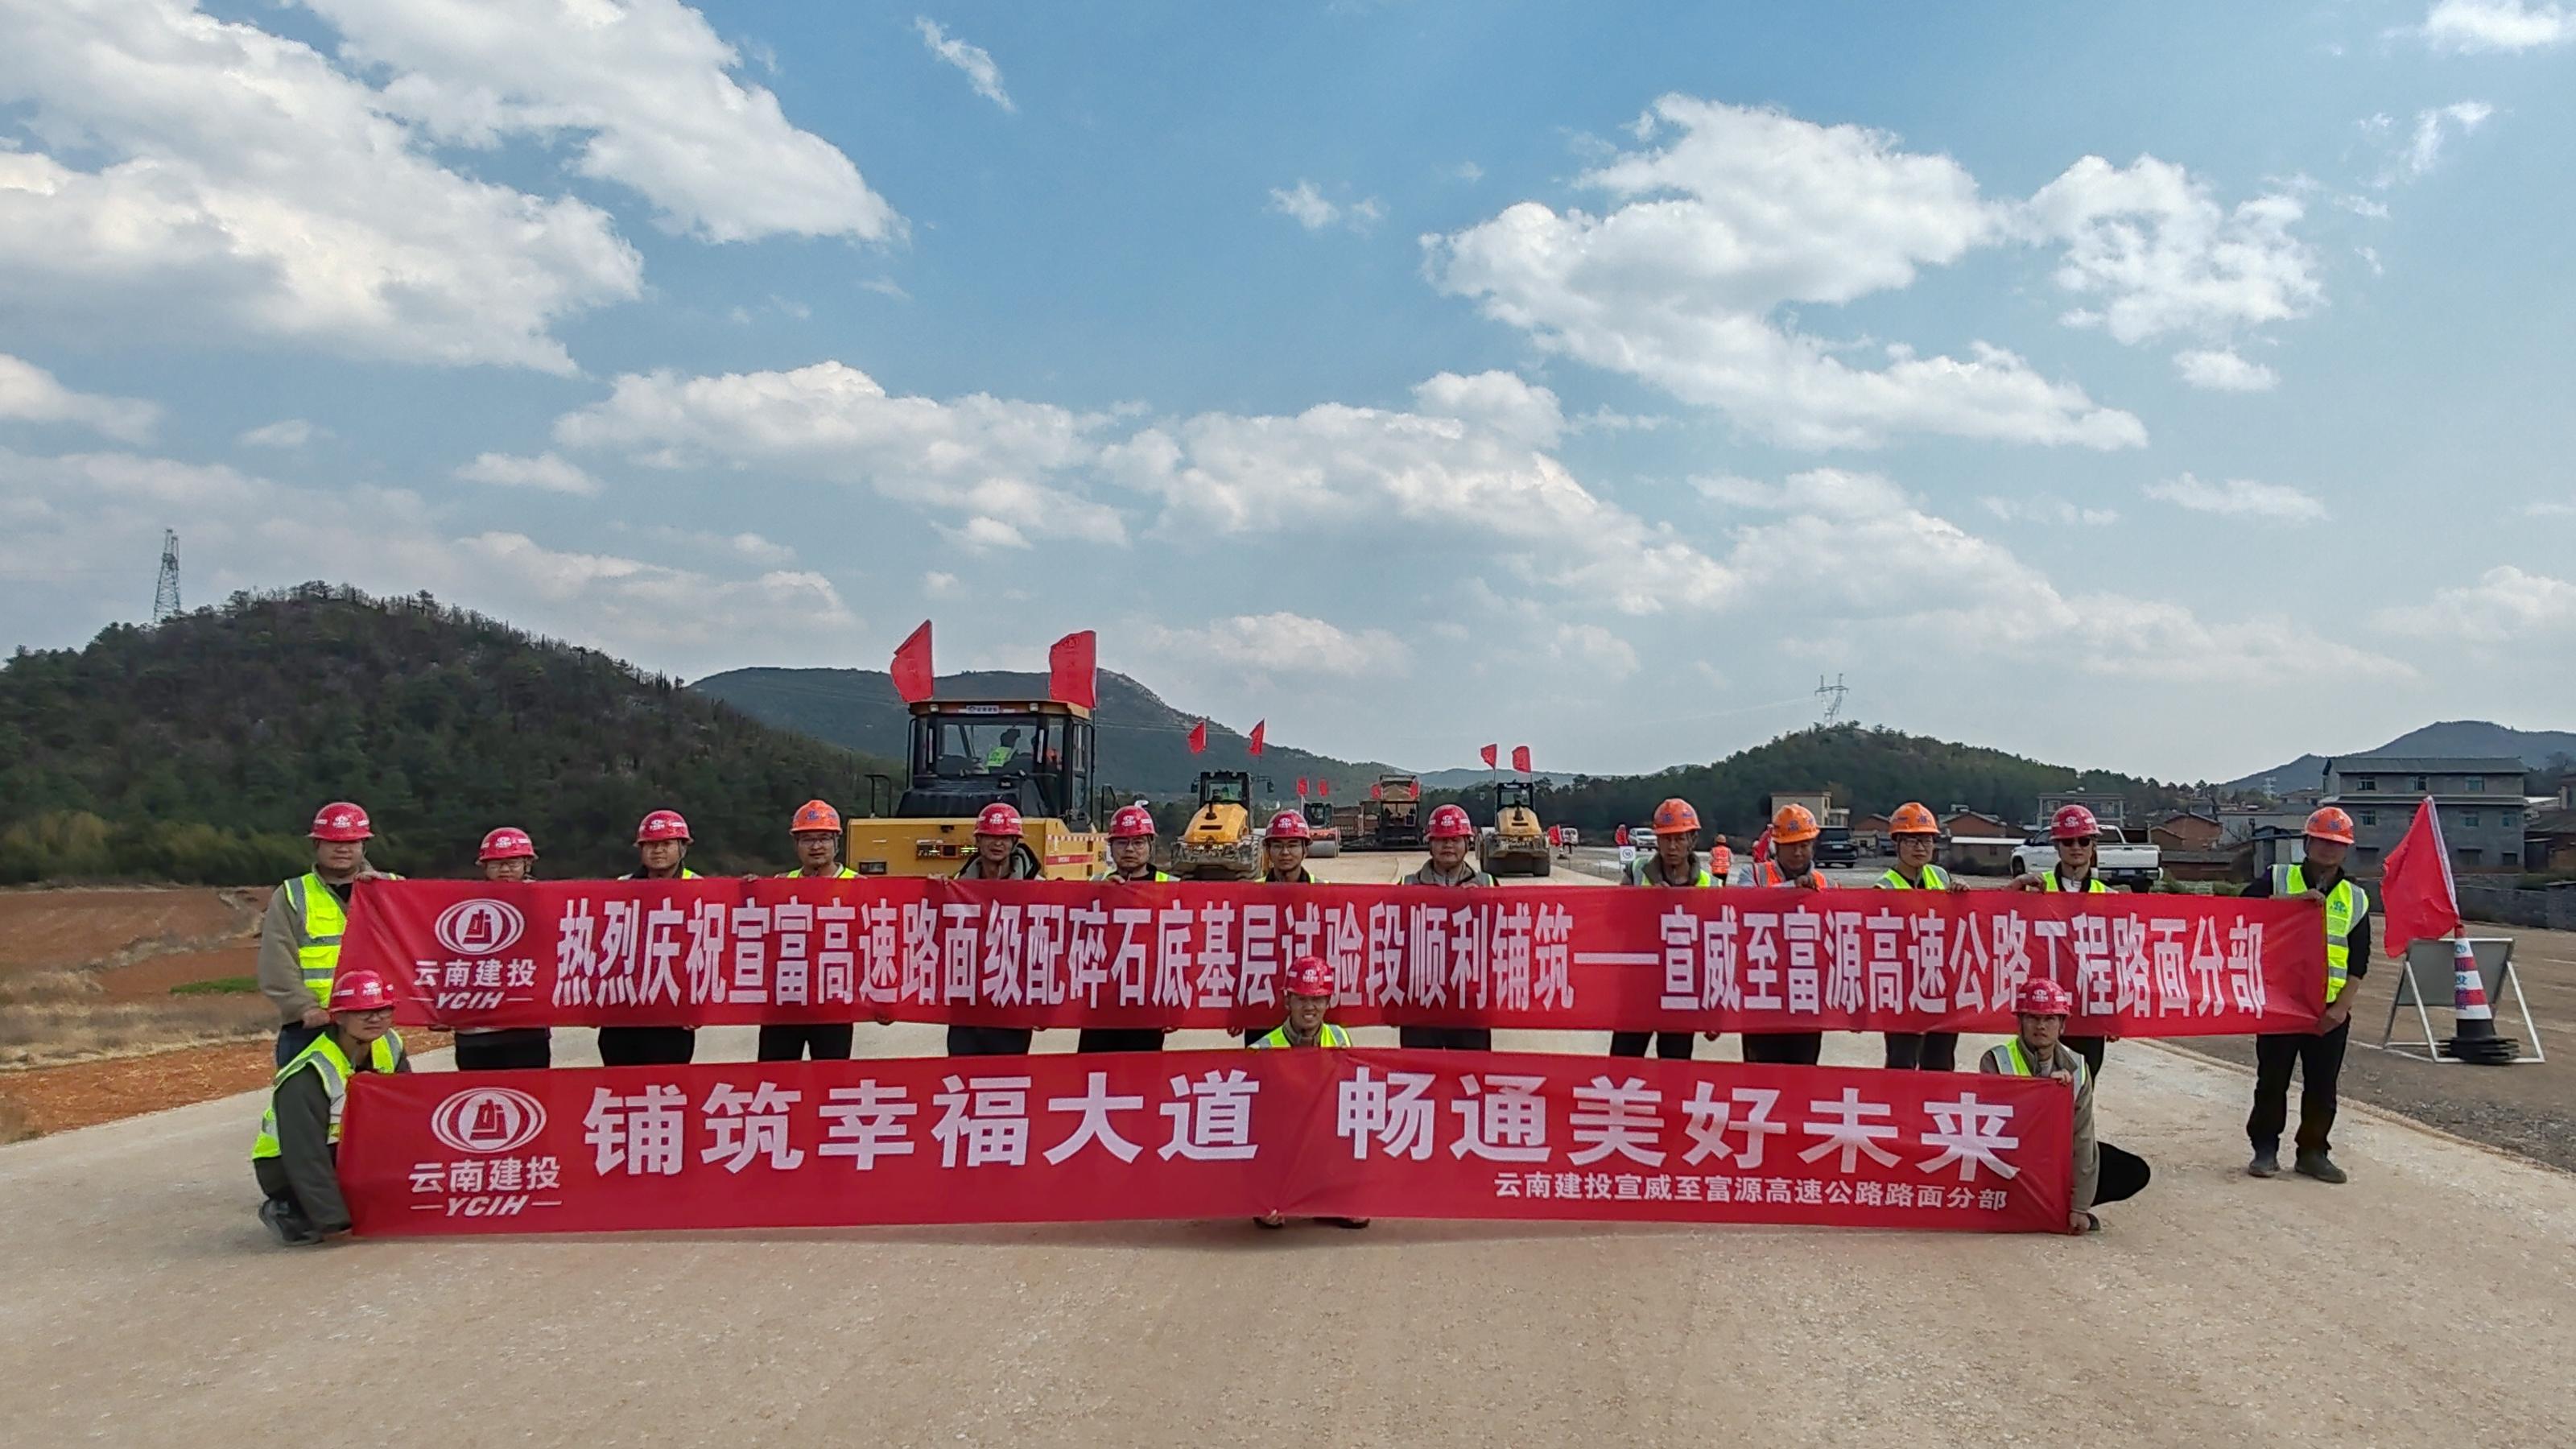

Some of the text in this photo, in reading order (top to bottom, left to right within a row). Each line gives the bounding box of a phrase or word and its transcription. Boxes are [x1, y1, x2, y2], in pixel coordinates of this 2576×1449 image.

[413, 958, 538, 988] 云南建投
[435, 991, 505, 1010] YCIH
[582, 1065, 2022, 1183] 铺筑幸福大道 畅通美好未来
[408, 1156, 562, 1194] 云南建投
[1493, 1170, 2008, 1212] 云南建投宣威至富源高速公路路面分部
[444, 1195, 530, 1217] YCIH
